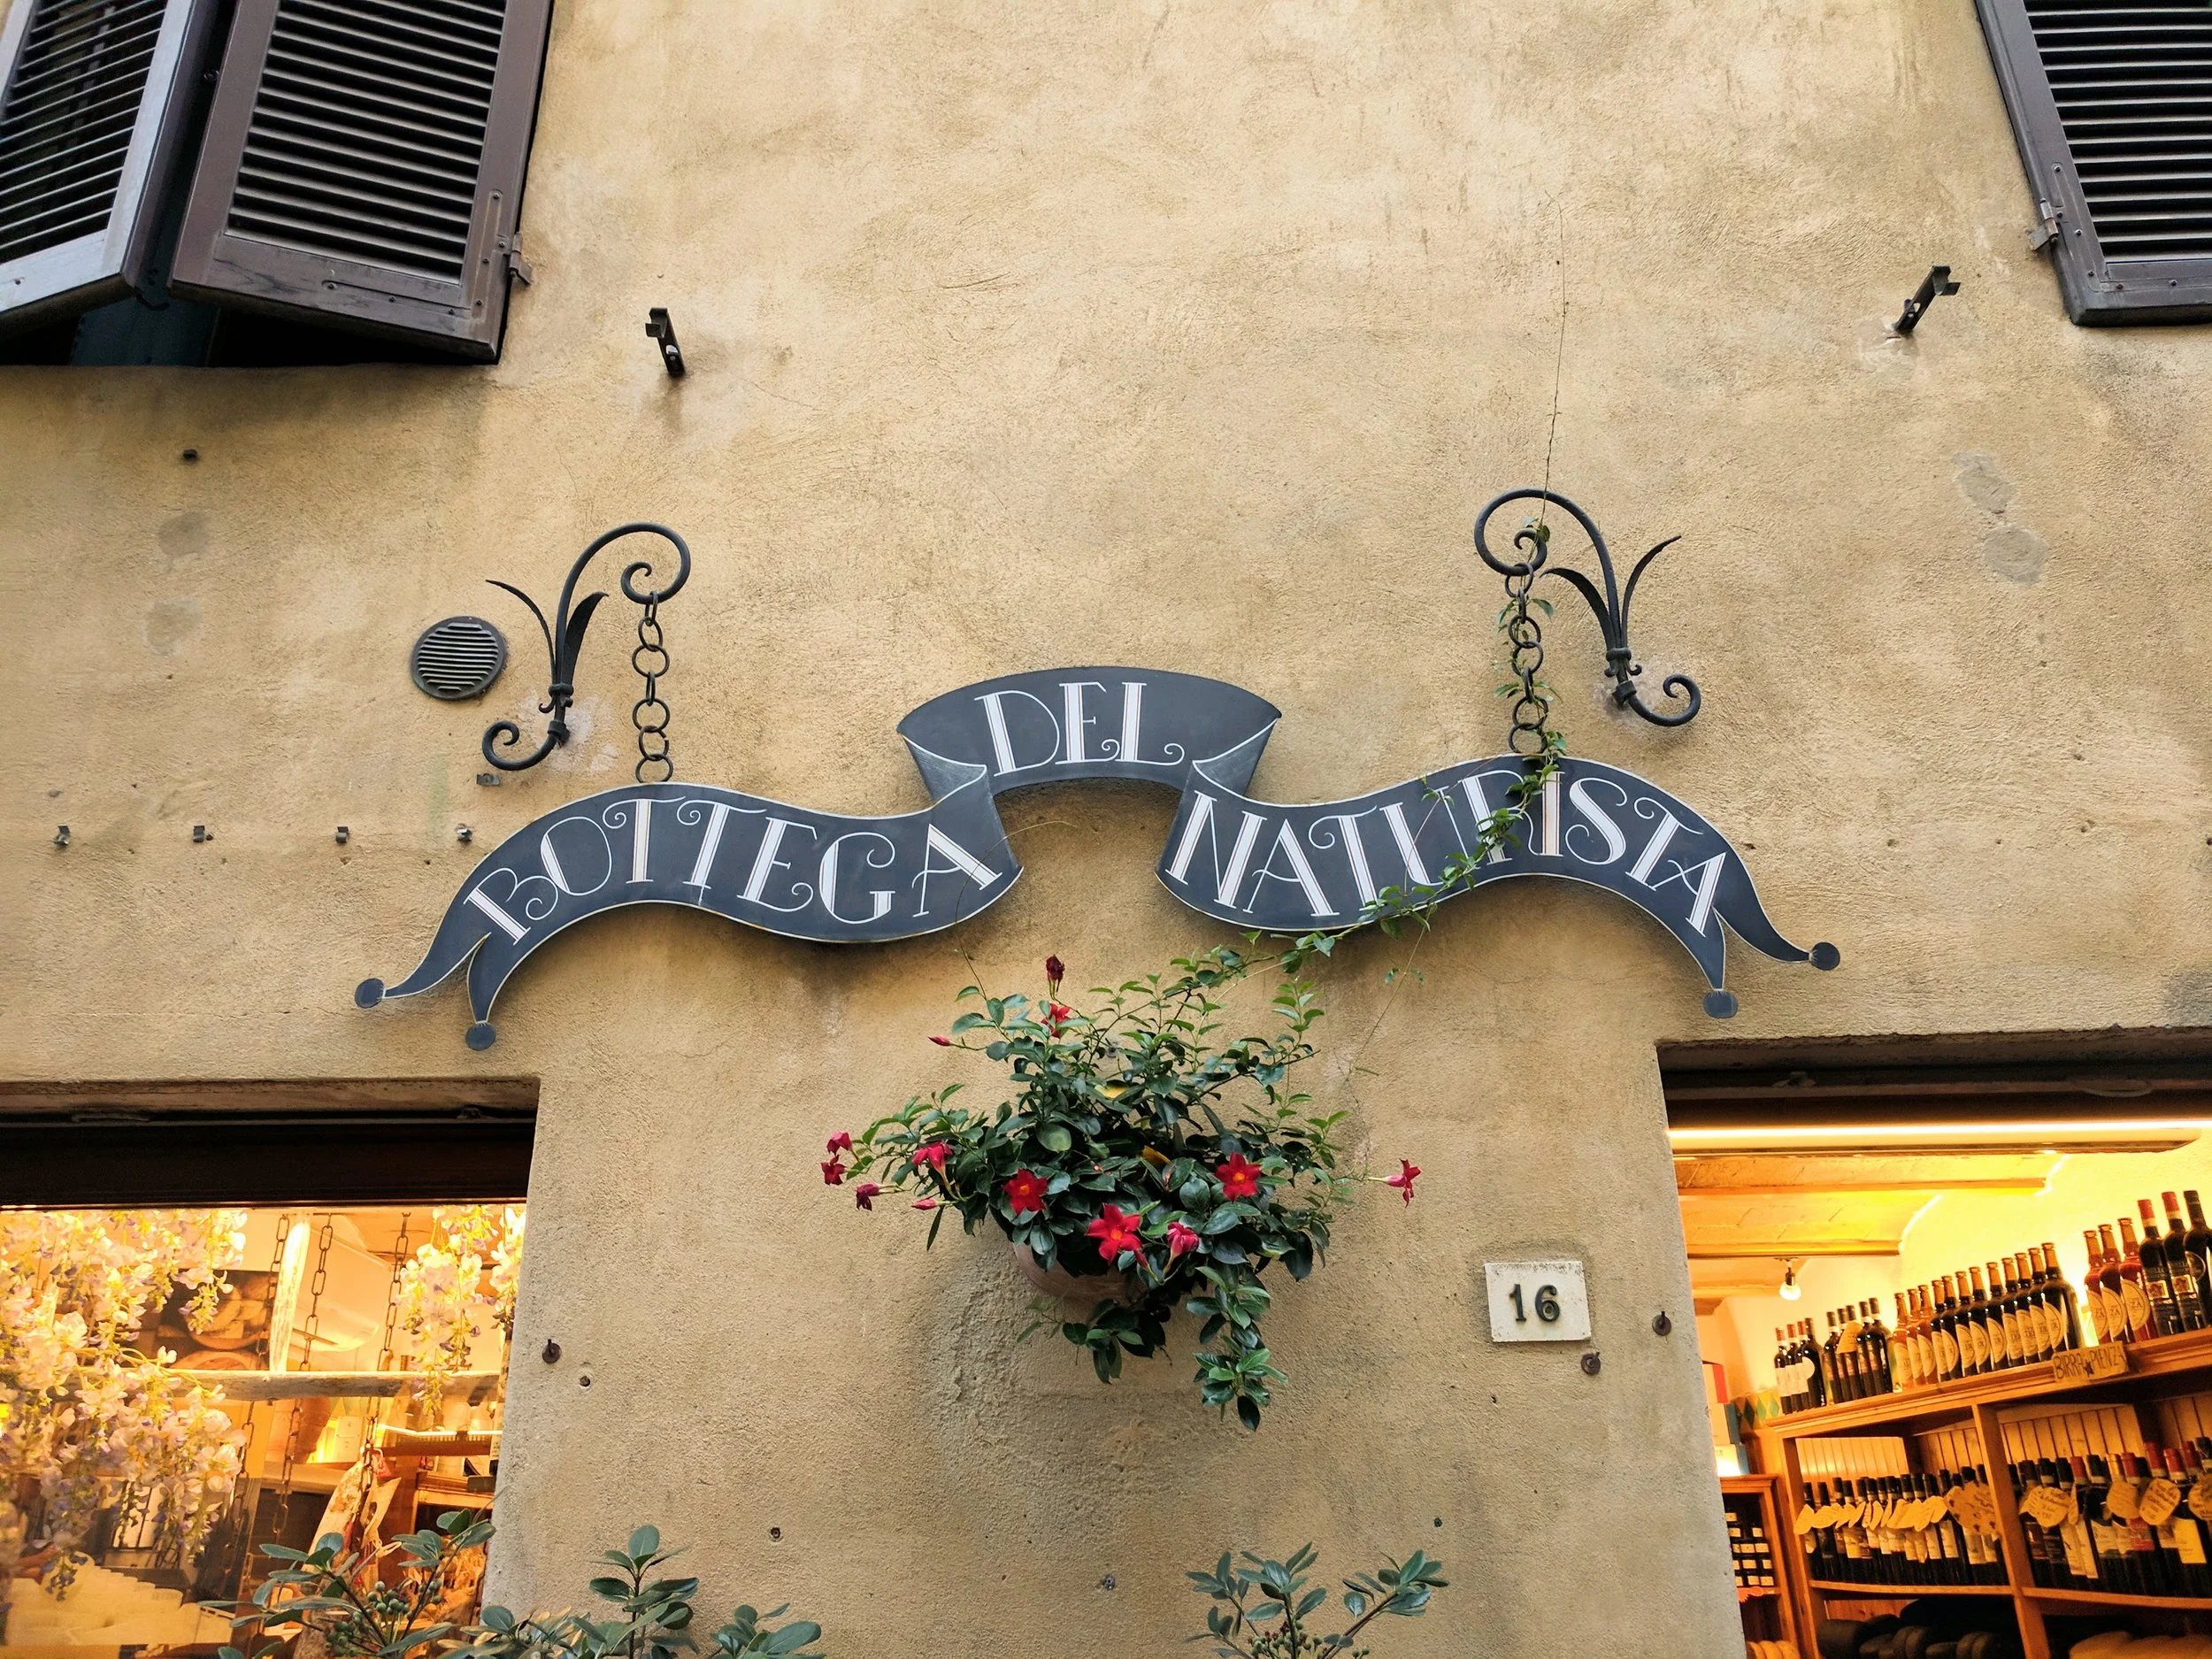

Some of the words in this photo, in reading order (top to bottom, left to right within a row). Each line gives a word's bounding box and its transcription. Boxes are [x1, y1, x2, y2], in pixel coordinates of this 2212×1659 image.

[464, 796, 1002, 945] BOTTEGA
[974, 681, 1185, 776] DEL
[1165, 769, 1726, 936] NATURISTA
[1509, 1283, 1561, 1322] 16
